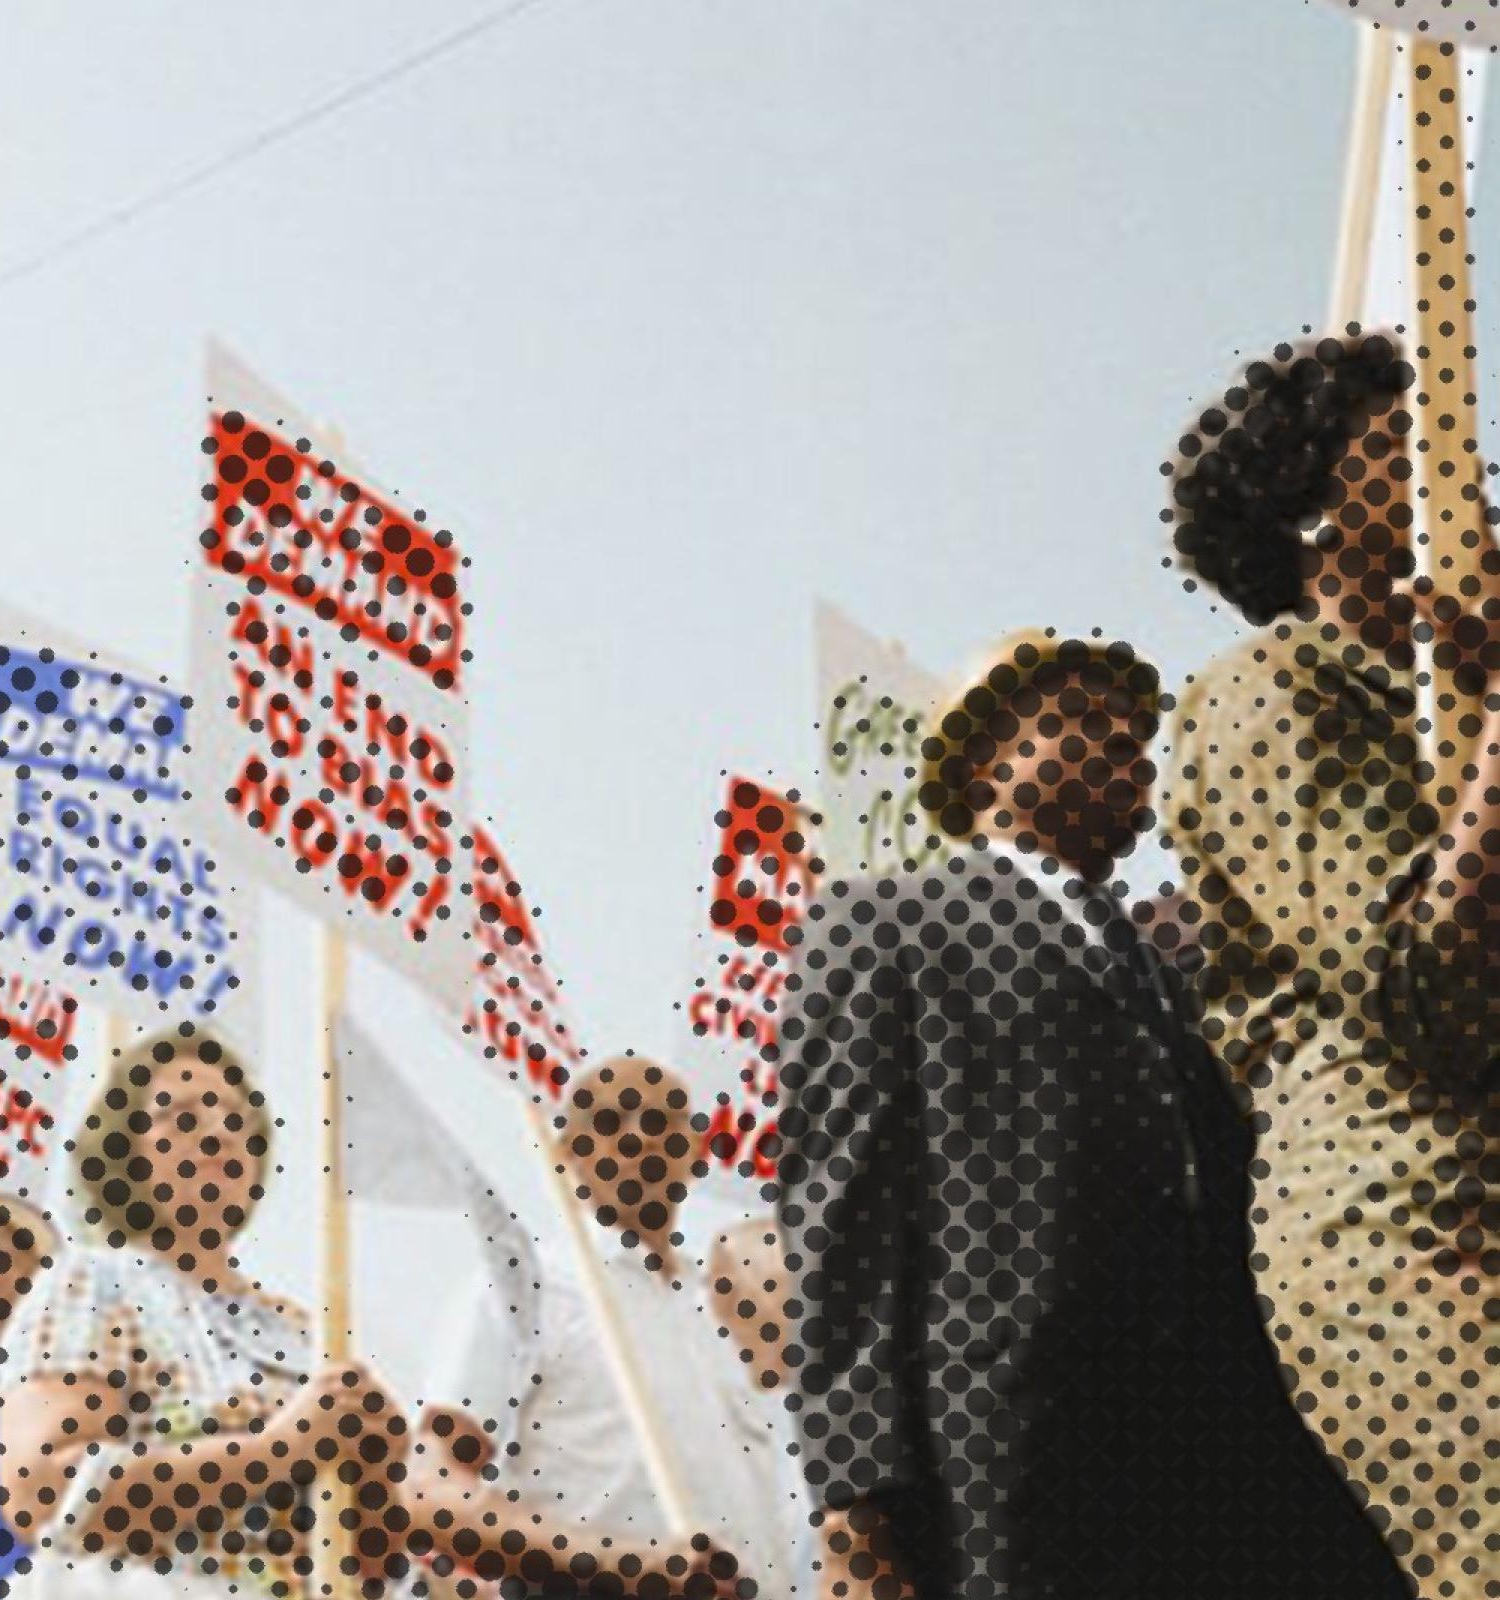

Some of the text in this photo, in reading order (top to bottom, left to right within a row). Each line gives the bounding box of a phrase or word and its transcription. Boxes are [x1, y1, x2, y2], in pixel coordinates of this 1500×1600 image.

[228, 496, 453, 658] DEMAND
[298, 466, 378, 560] WE
[70, 668, 164, 733] WE
[230, 598, 454, 792] AN END
[233, 662, 452, 860] TO BIAS
[8, 828, 228, 953] RIGHTS
[16, 774, 218, 897] EQUAL
[228, 756, 450, 940] NOW!
